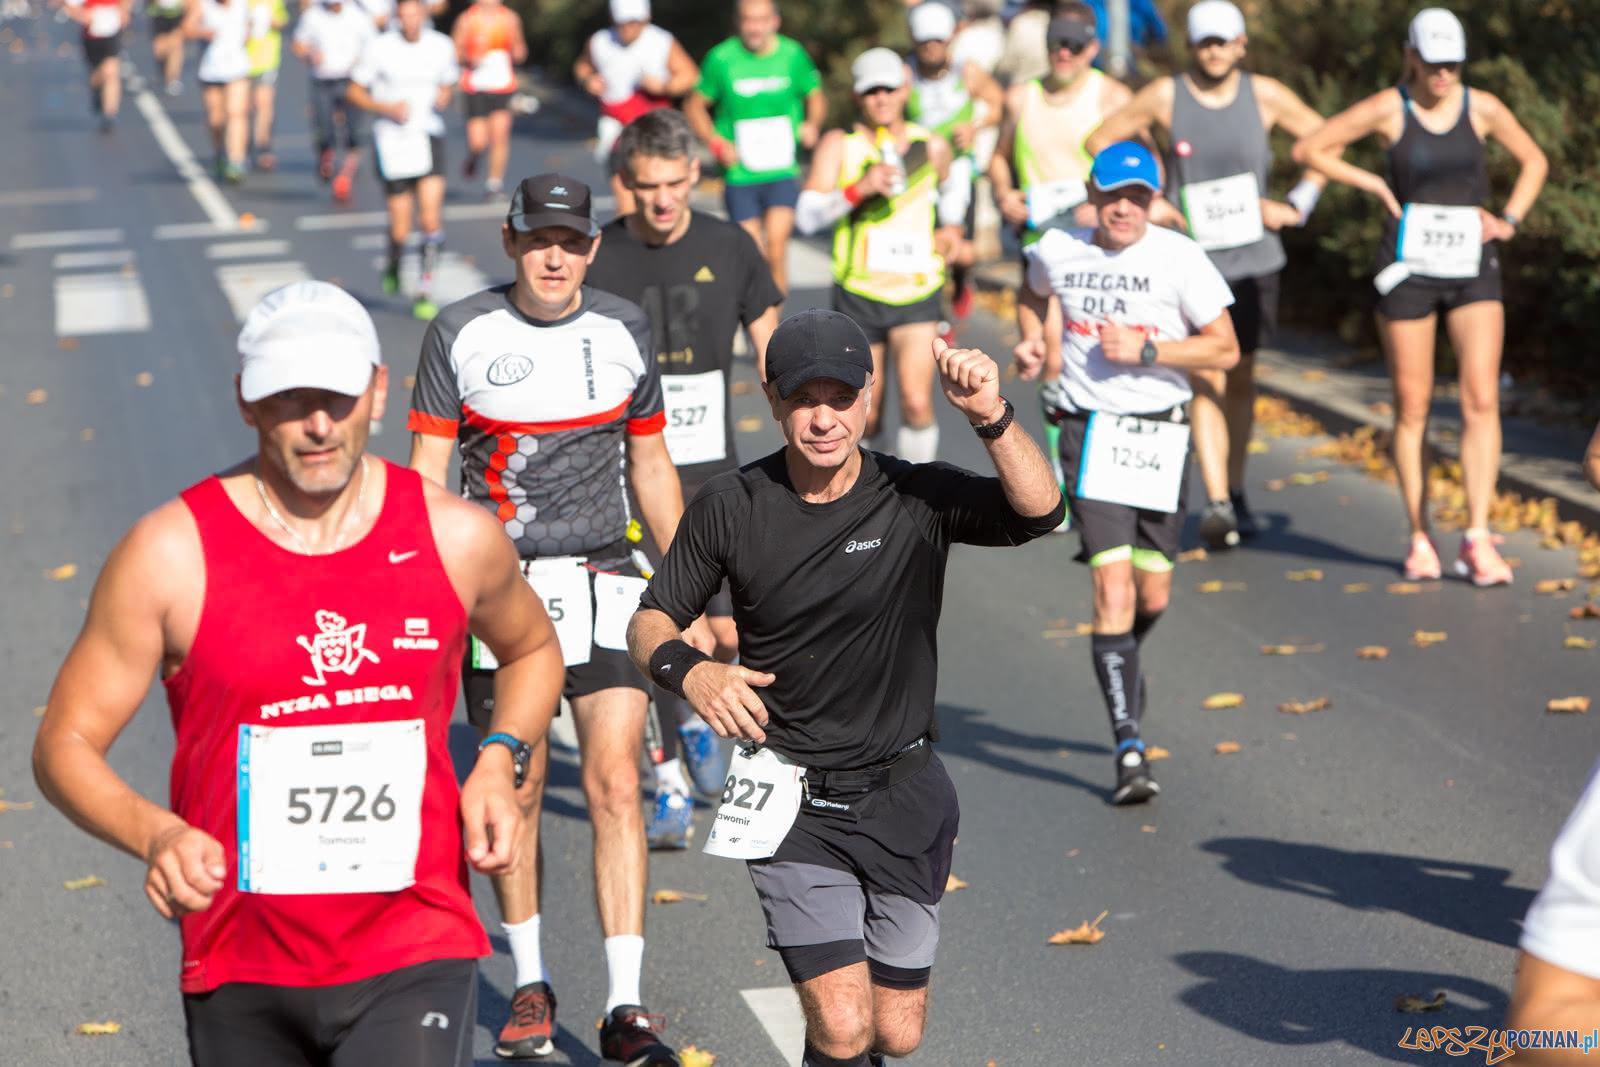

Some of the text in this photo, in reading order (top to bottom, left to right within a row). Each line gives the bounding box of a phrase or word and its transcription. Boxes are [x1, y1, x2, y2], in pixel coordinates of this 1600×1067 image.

[1064, 271, 1150, 292] BIEGAM
[1083, 295, 1127, 314] DLA
[1112, 445, 1161, 472] 1254
[260, 684, 413, 720] NYSA BIEGA
[287, 783, 396, 825] 5726
